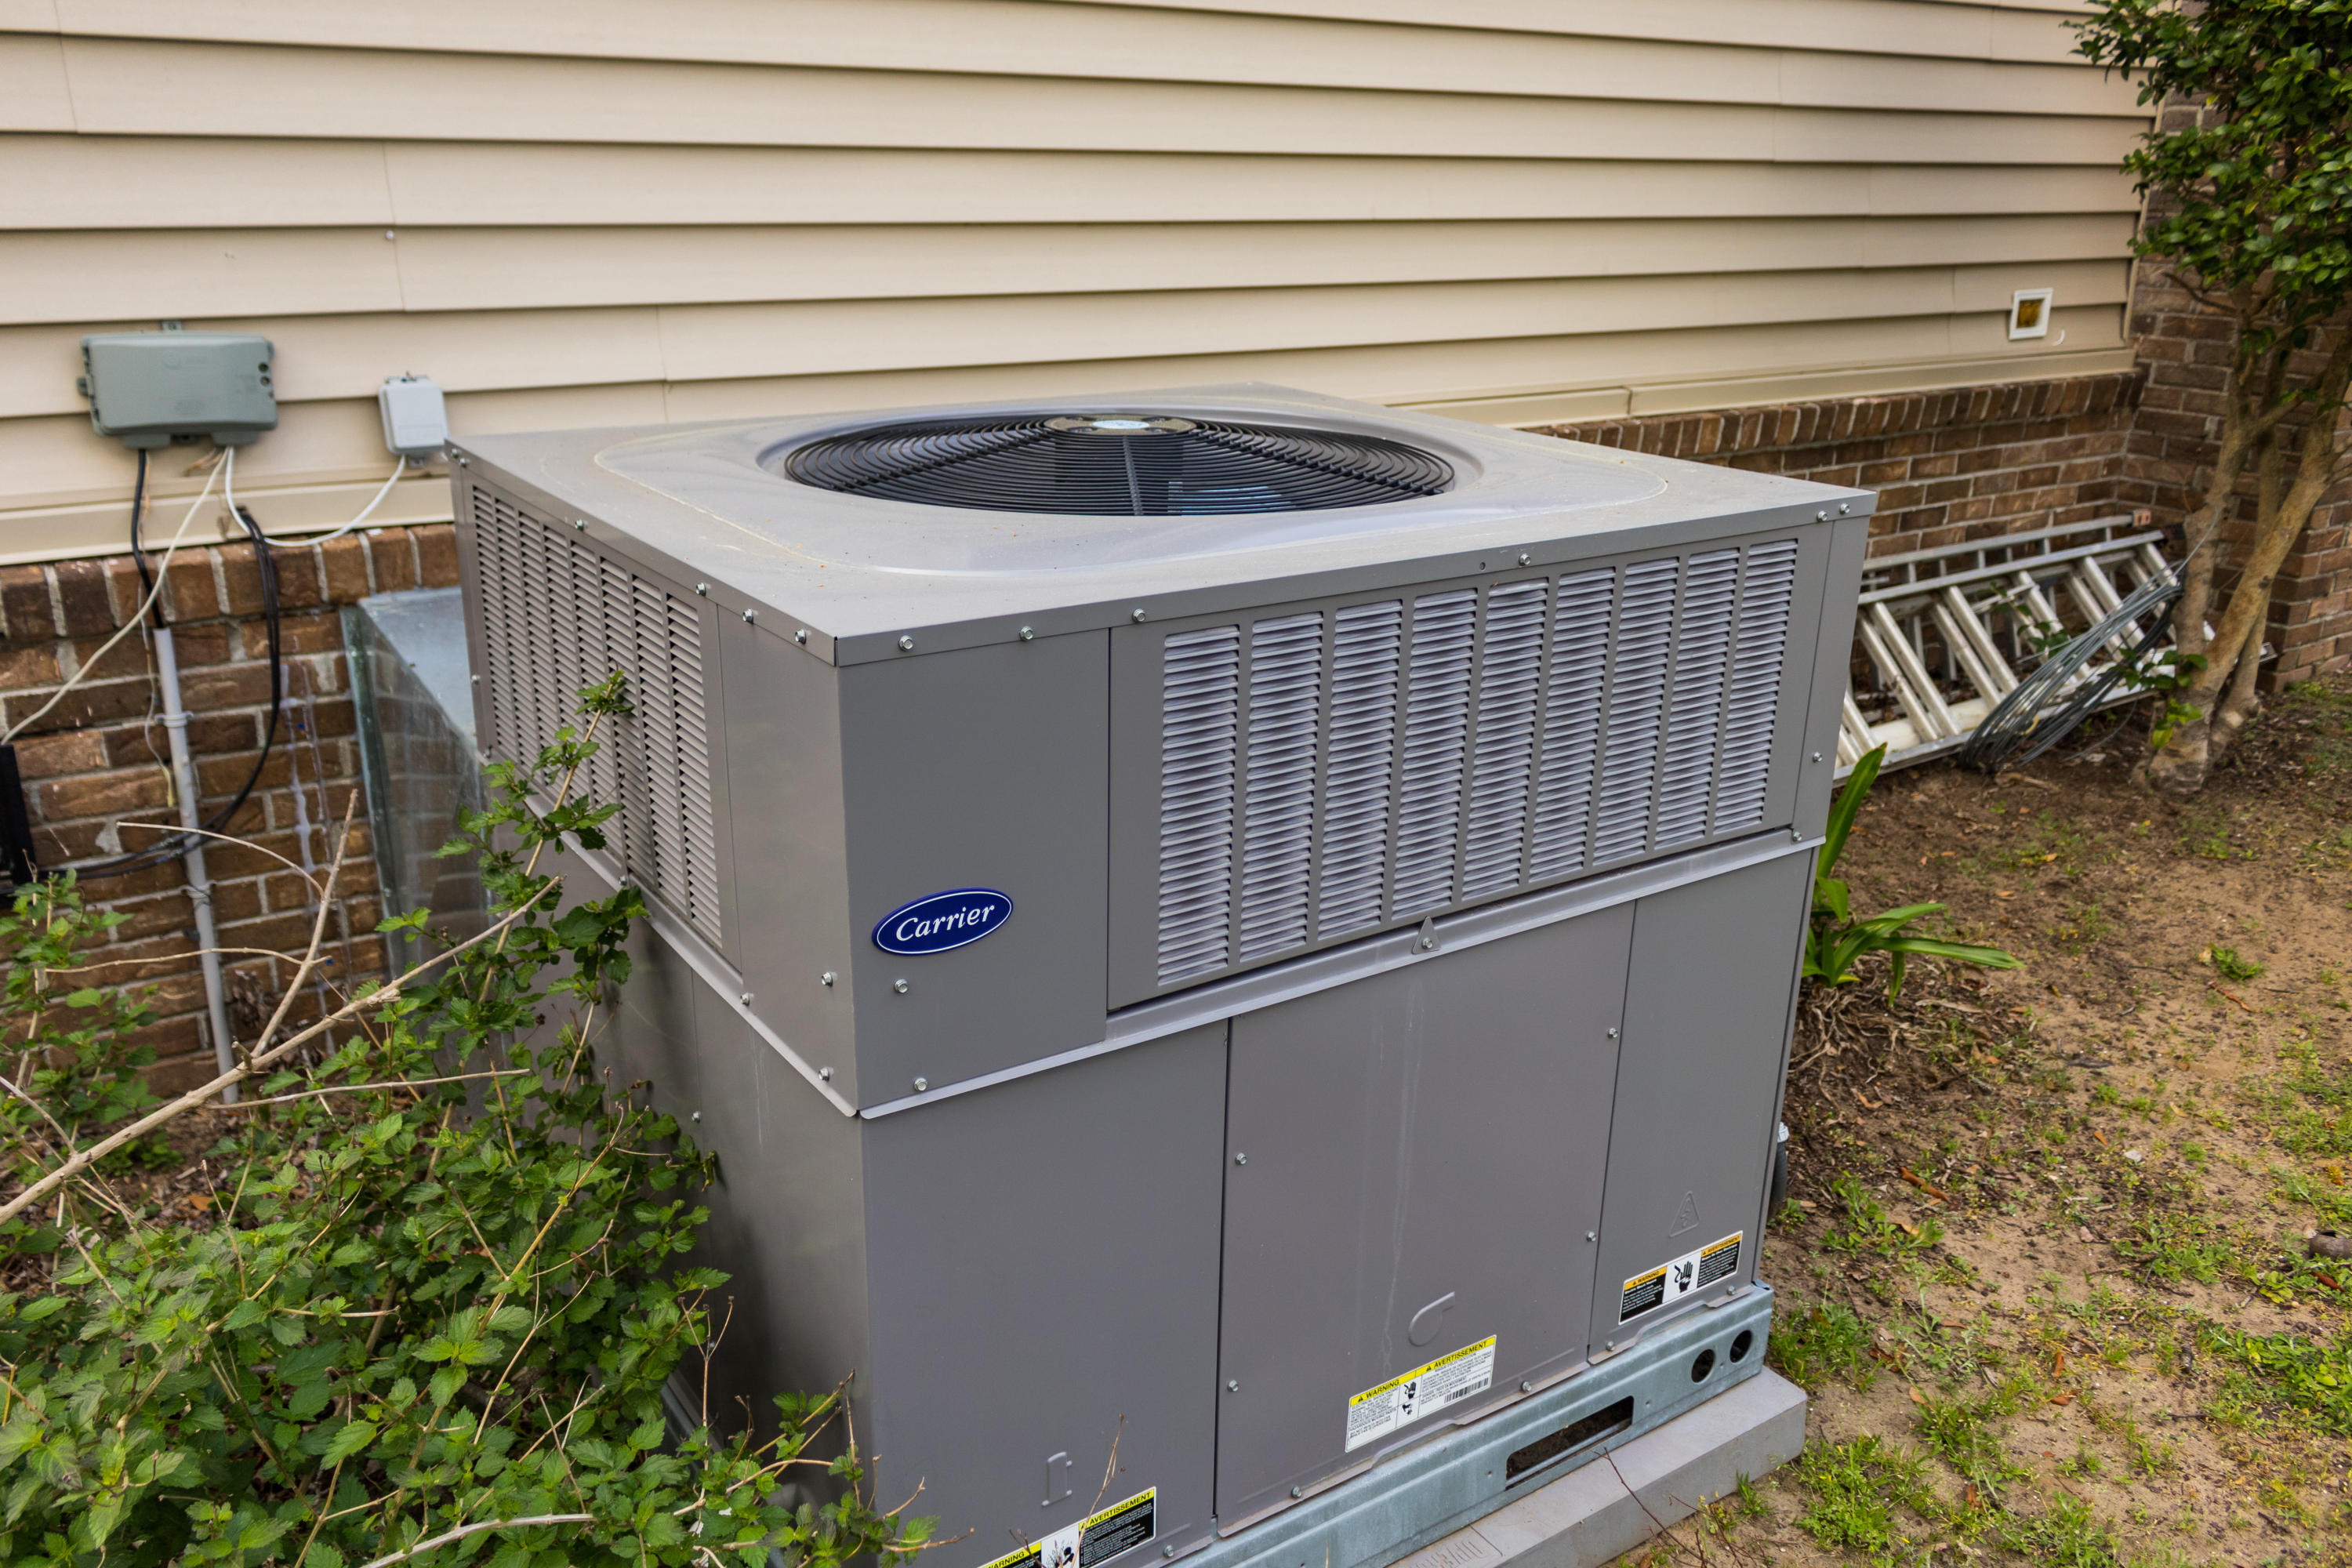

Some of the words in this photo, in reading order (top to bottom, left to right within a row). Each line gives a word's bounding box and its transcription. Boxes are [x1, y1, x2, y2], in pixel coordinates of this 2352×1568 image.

[896, 904, 995, 942] Carrier
[1433, 1341, 1486, 1368] AVERTISSEMENT
[1366, 1379, 1399, 1398] WARNING
[1089, 1492, 1150, 1525] AVERTISSEMENT
